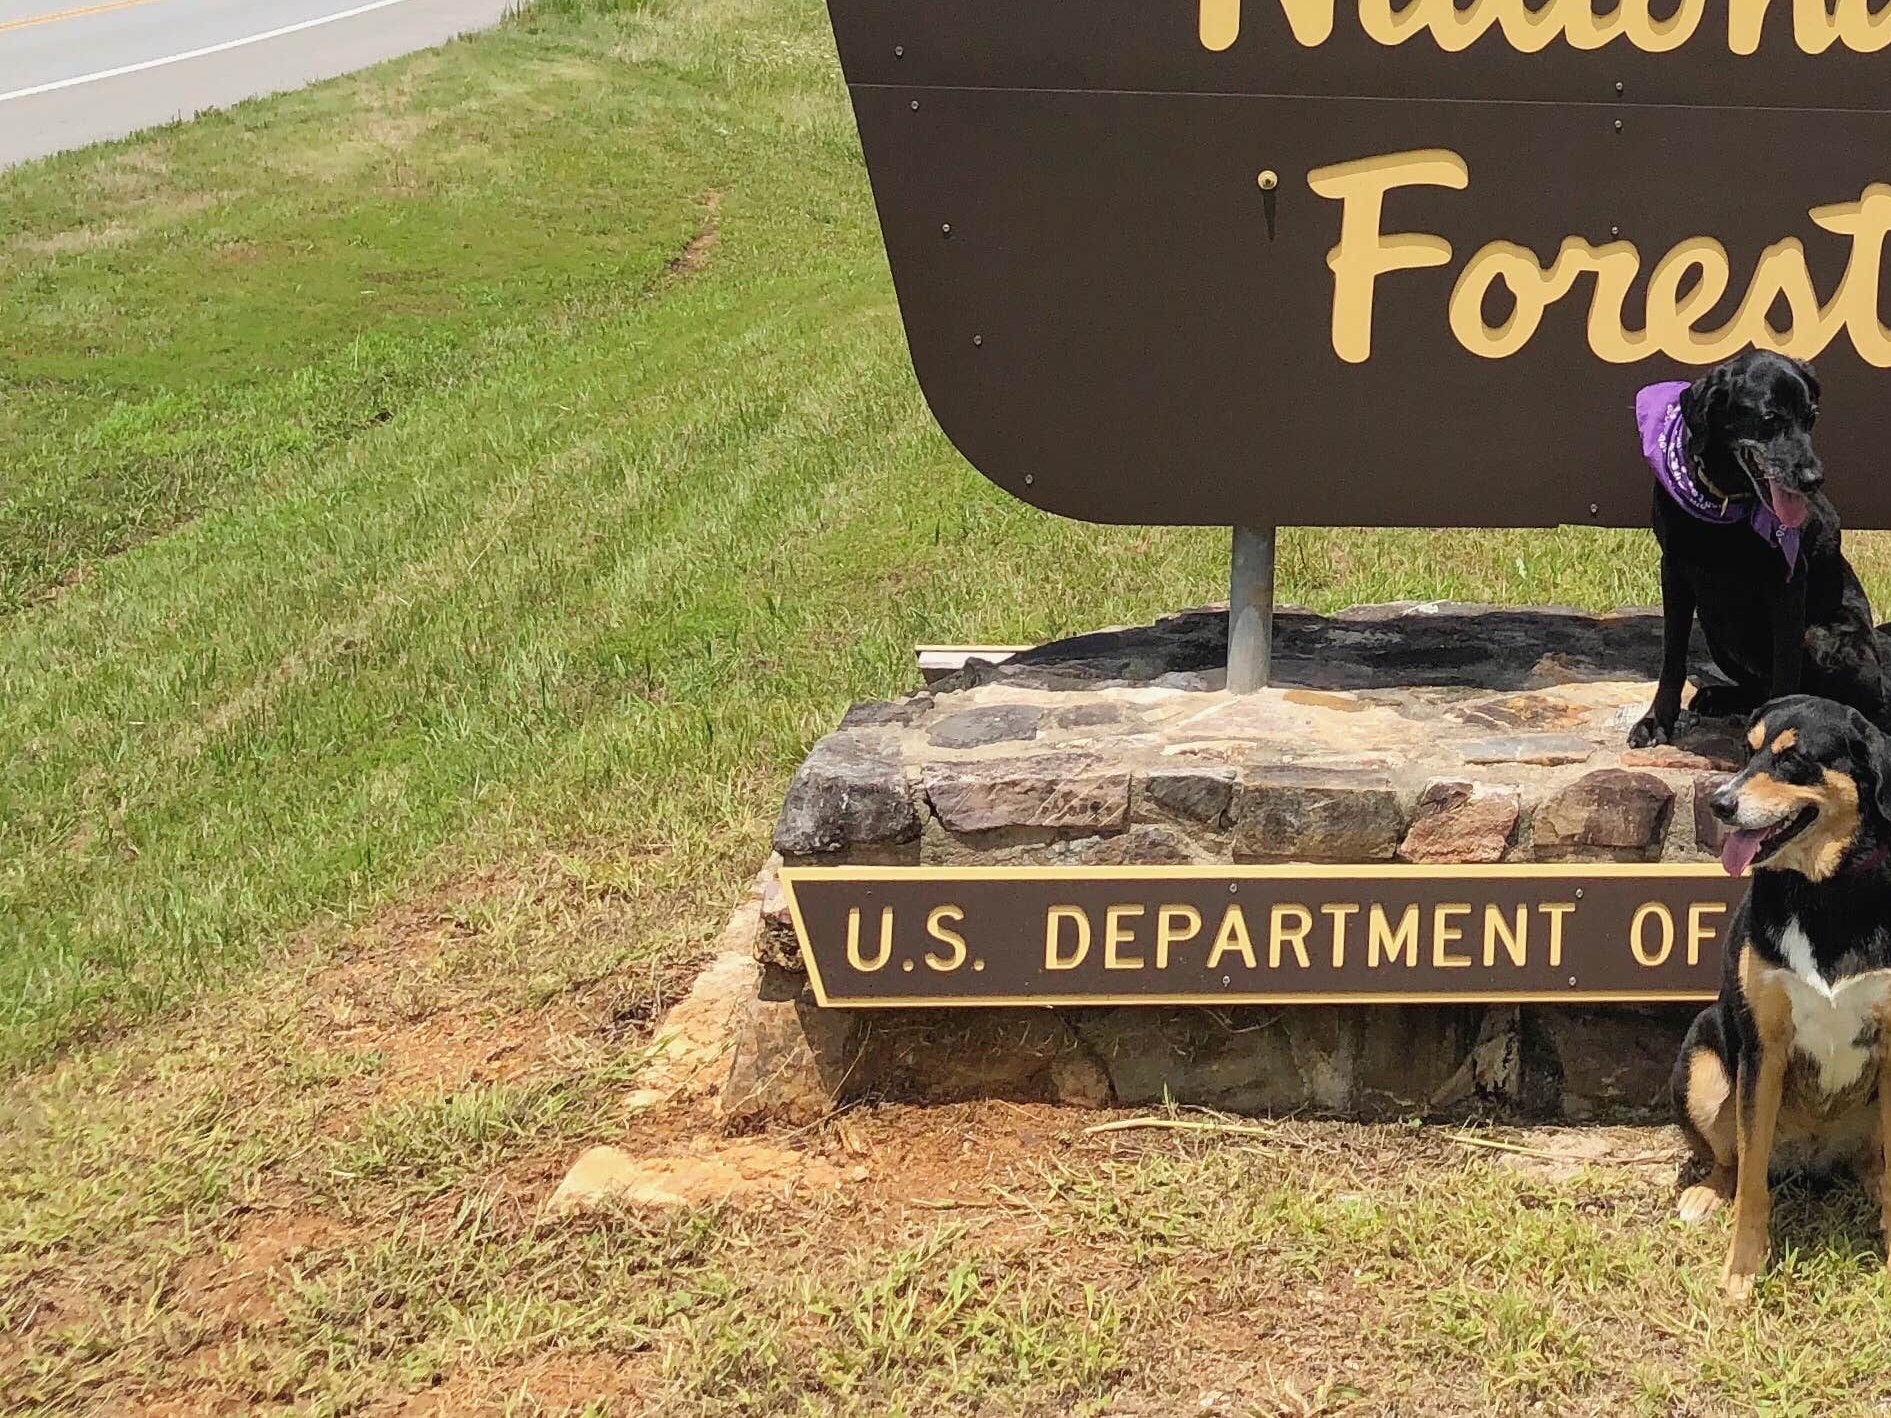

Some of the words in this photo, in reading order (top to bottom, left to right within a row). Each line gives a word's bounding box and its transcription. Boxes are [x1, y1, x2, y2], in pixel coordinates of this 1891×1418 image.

[846, 904, 985, 973] U.S.
[1044, 902, 1576, 970] DEPARTMENT
[1629, 901, 1728, 967] OF
